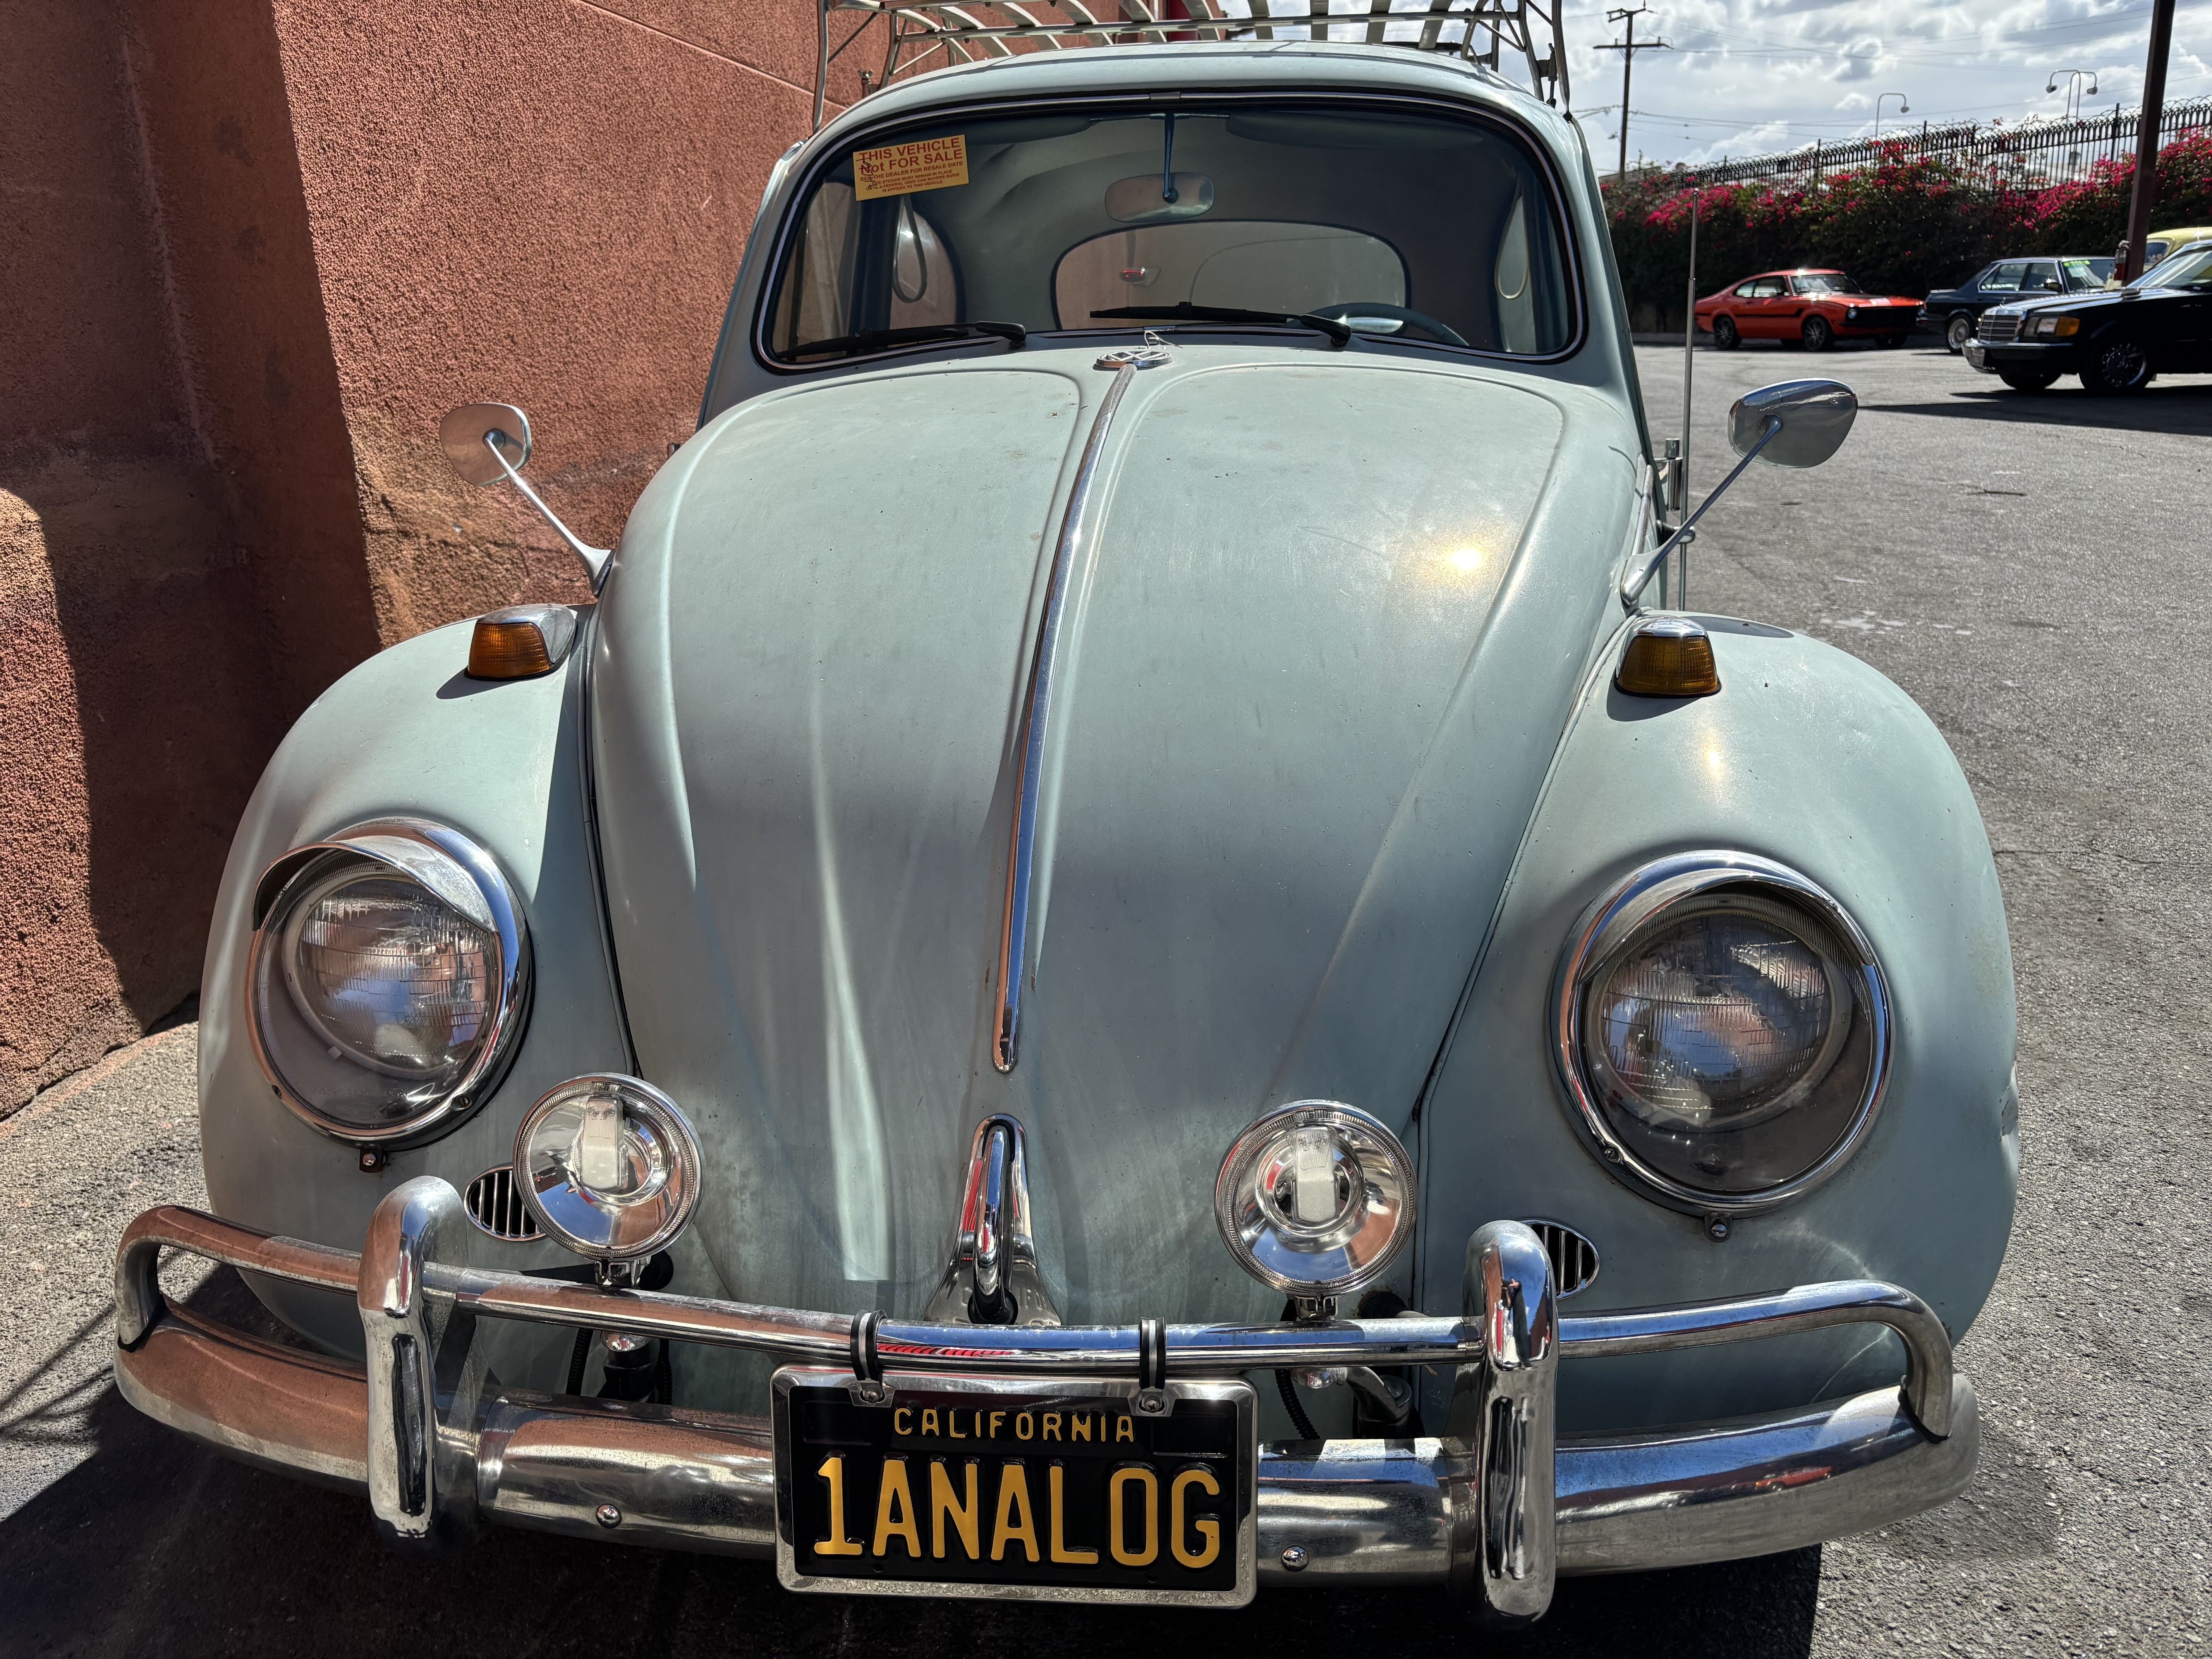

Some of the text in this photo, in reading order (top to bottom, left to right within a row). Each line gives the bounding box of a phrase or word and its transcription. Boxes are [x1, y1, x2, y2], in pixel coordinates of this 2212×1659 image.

[859, 137, 960, 161] THIS VEHICLE
[861, 162, 884, 174] Not
[889, 156, 919, 170] FOR
[924, 149, 963, 164] SALE
[895, 1408, 1135, 1443] CALIFORNIA
[814, 1456, 1221, 1568] 1ANALOG
